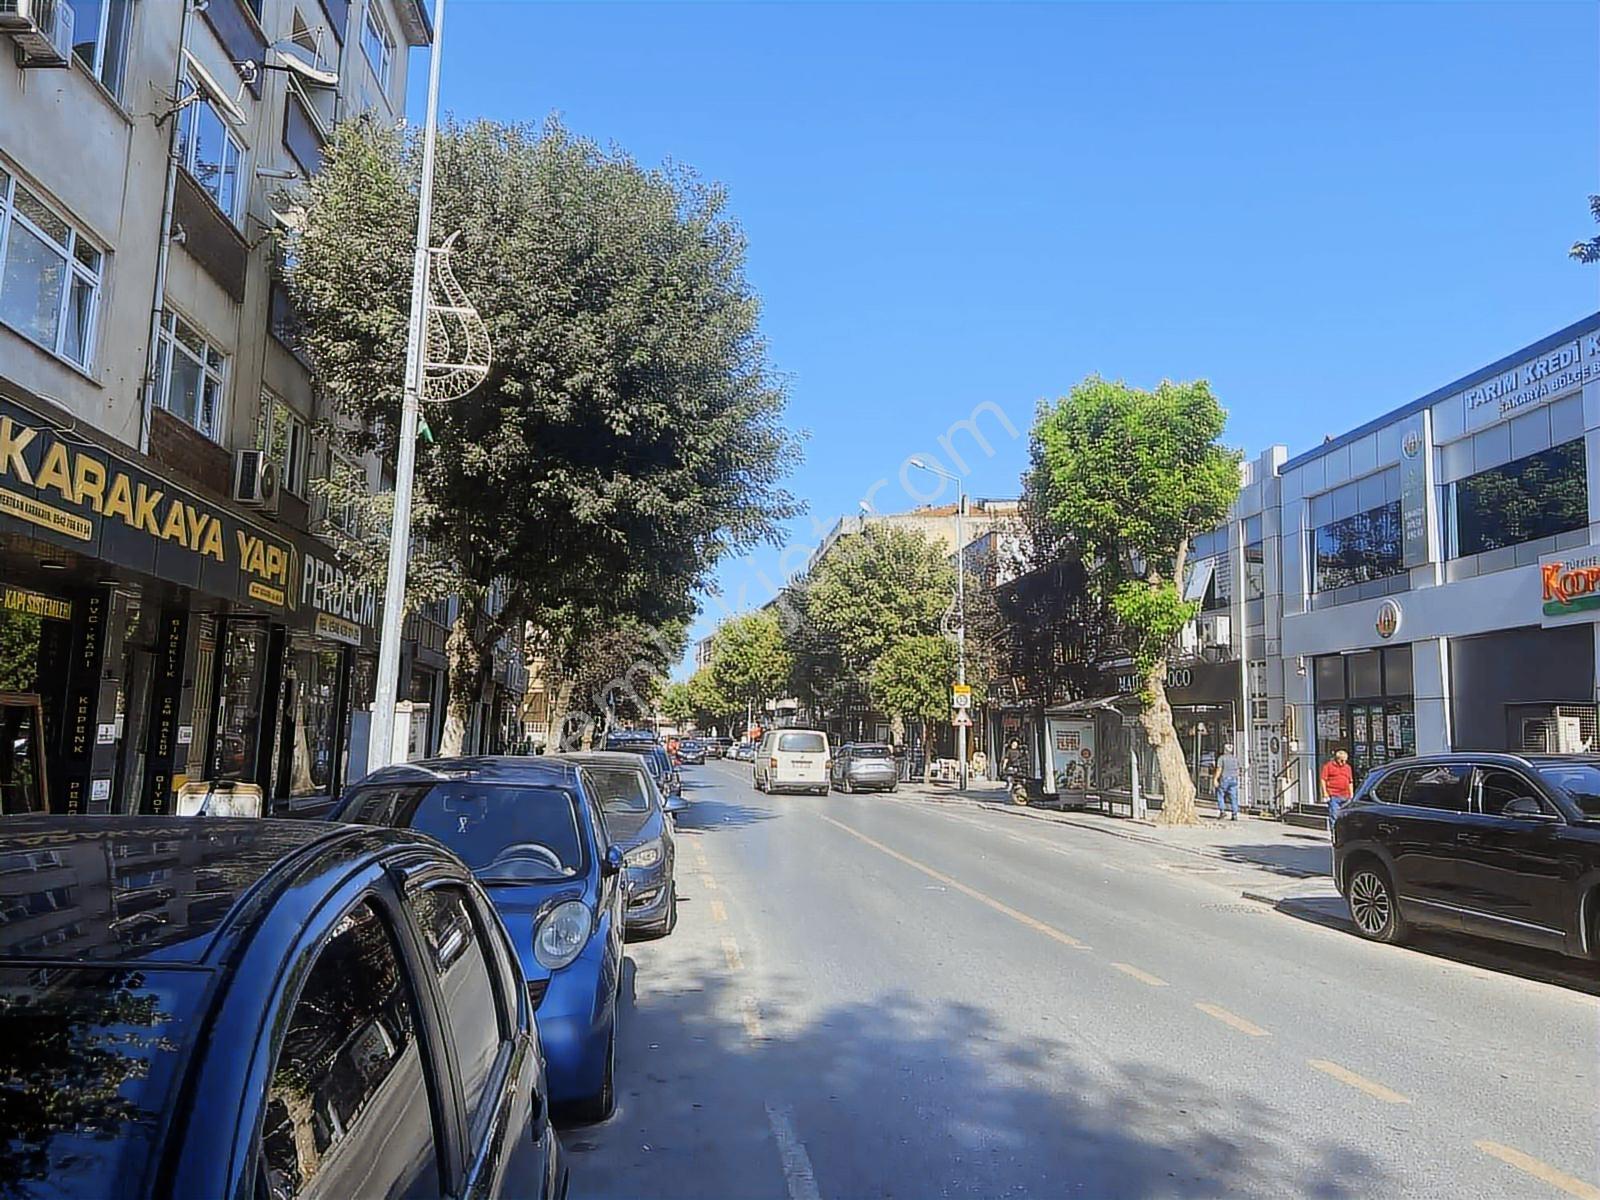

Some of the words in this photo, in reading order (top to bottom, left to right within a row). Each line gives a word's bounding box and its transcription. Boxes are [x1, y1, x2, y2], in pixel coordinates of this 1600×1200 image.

[1465, 371, 1519, 410] TARIM
[0, 415, 226, 562] KARAKAYA
[236, 529, 288, 586] YAPI
[4, 588, 27, 612] KAPI
